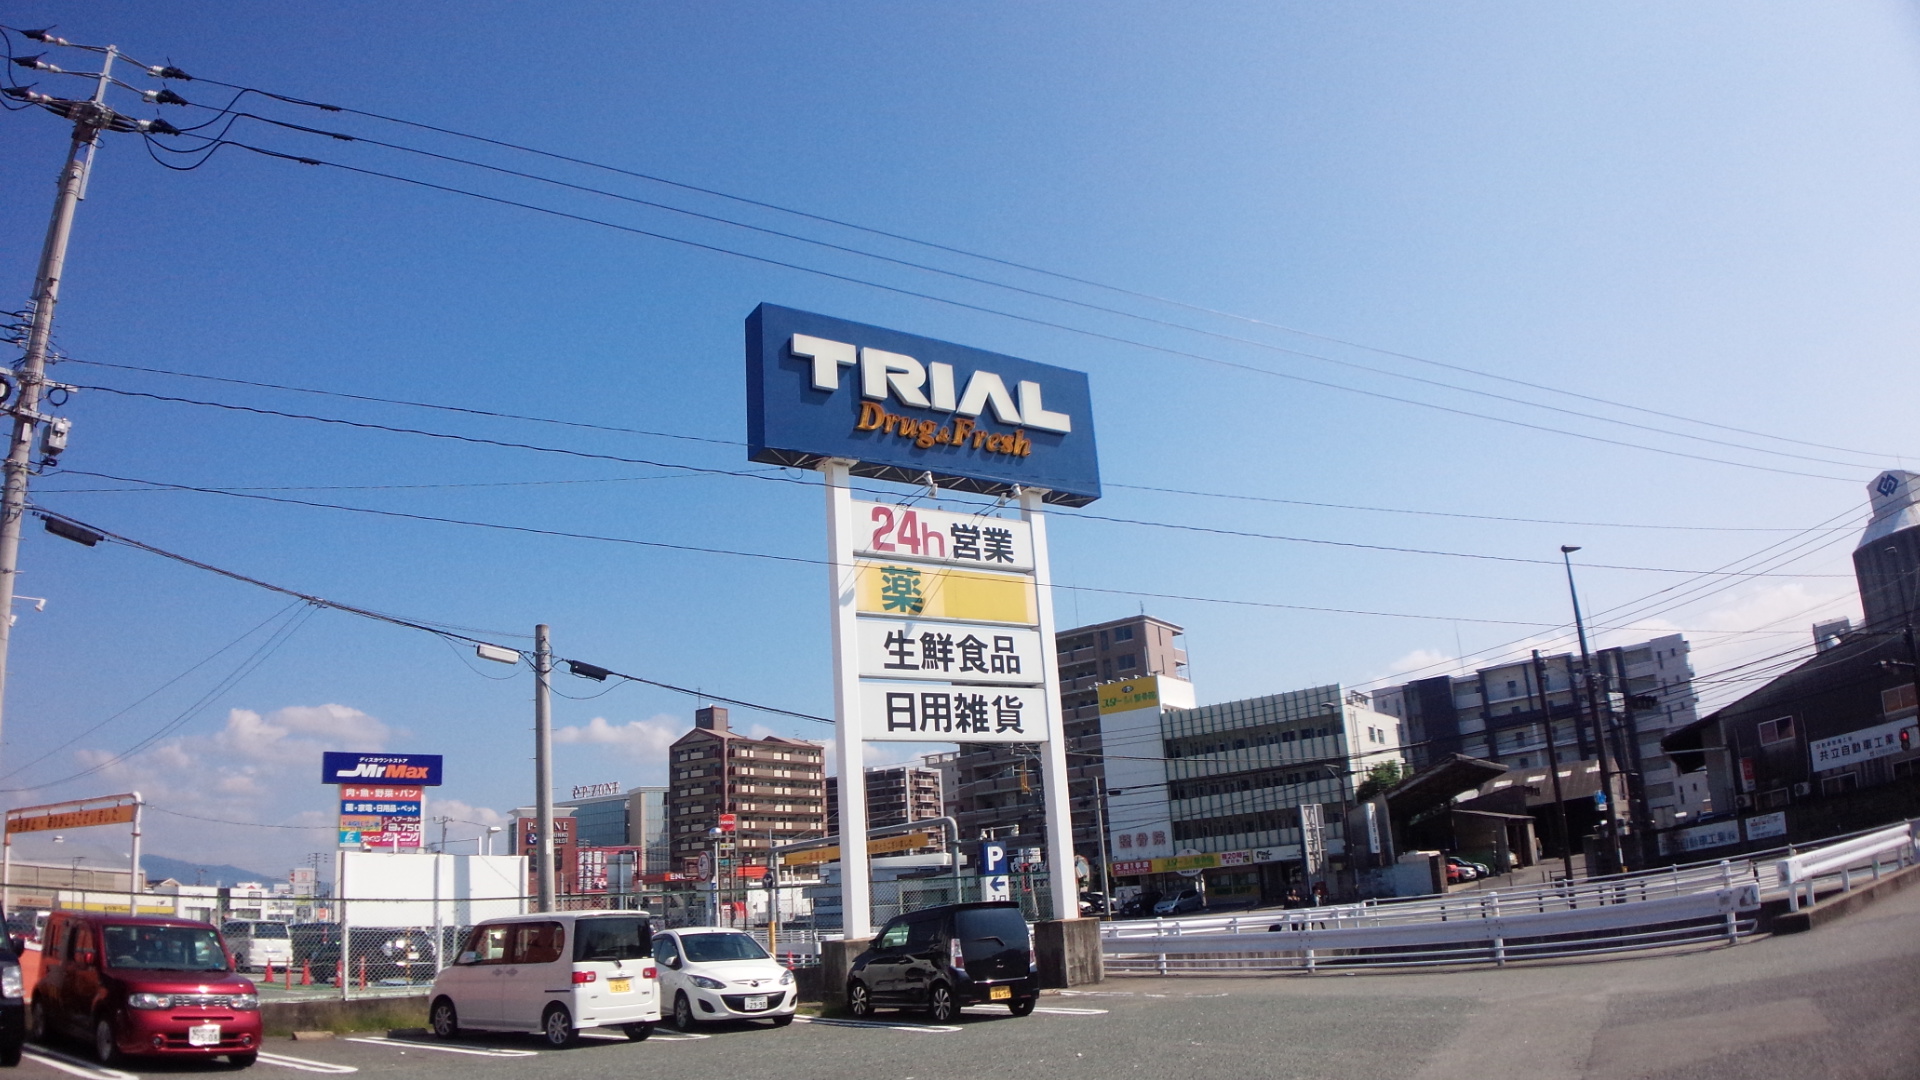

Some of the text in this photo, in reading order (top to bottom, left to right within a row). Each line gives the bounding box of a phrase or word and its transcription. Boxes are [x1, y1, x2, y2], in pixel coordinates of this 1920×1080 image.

[791, 333, 1071, 434] TRIAL
[880, 565, 924, 614] 薬
[884, 629, 1021, 674] 生鮮食品
[886, 692, 1025, 734] 日用雑貨
[1820, 733, 1894, 762] 共立自動車工業
[336, 763, 429, 779] MrMax
[1118, 830, 1166, 849] 整骨院
[987, 845, 1004, 871] P
